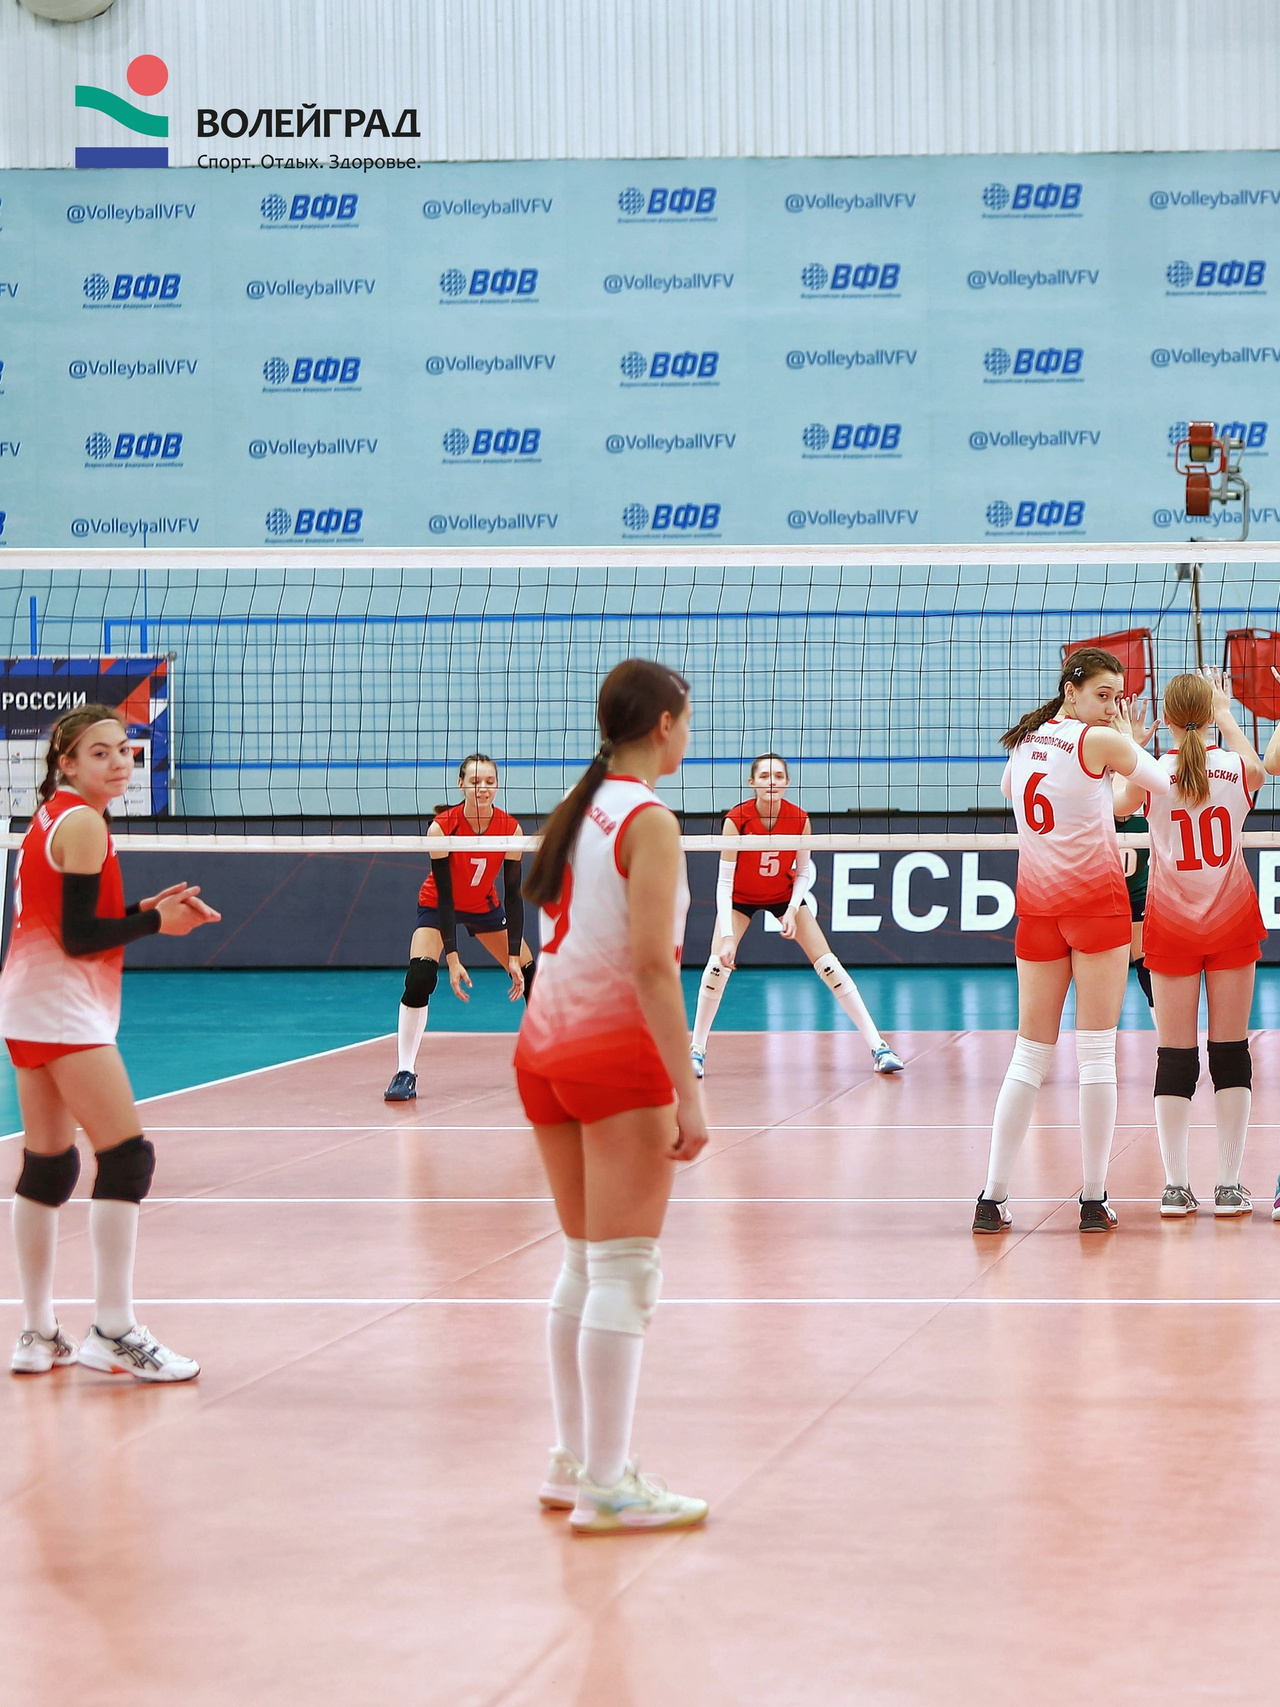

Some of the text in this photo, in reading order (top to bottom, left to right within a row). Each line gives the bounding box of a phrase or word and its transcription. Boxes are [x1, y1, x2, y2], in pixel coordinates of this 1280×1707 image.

[289, 193, 359, 221] ВФВ
[423, 198, 552, 219] @VolleyballVFV
[647, 187, 717, 215] ВФВ
[784, 192, 916, 213] @VolleyballVFV
[1012, 183, 1083, 210] ВФВ
[67, 203, 196, 224] @VolleyballVFV
[112, 273, 182, 301] ВФВ
[469, 268, 539, 296] ВФВ
[603, 273, 734, 294] @VolleyballVFV
[831, 263, 901, 291] ВФВ
[967, 269, 1099, 290] @VolleyballVFV
[1196, 260, 1267, 288] ВФВ
[246, 278, 375, 300] @VolleyballVFV
[69, 358, 197, 379] @VolleyballVFV
[292, 356, 362, 385] ВФВ
[425, 354, 555, 376] @VolleyballVFV
[649, 351, 720, 379] ВФВ
[785, 349, 917, 370] @VolleyballVFV
[1013, 347, 1084, 376] ВФВ
[114, 432, 183, 460] ВФВ
[249, 438, 378, 459] @VolleyballVFV
[472, 428, 542, 456] ВФВ
[605, 433, 736, 454] @VolleyballVFV
[831, 423, 902, 451] ВФВ
[968, 430, 1101, 451] @VolleyballVFV
[294, 507, 364, 536] ВФВ
[428, 513, 558, 535] @VolleyballVFV
[651, 503, 722, 531] ВФВ
[787, 509, 919, 530] @VolleyballVFV
[1015, 500, 1086, 528] ВФВ
[2, 691, 87, 711] РОССИИ
[1023, 772, 1055, 835] 6
[1170, 805, 1233, 872] 10
[470, 857, 487, 887] 7
[759, 851, 781, 877] 5
